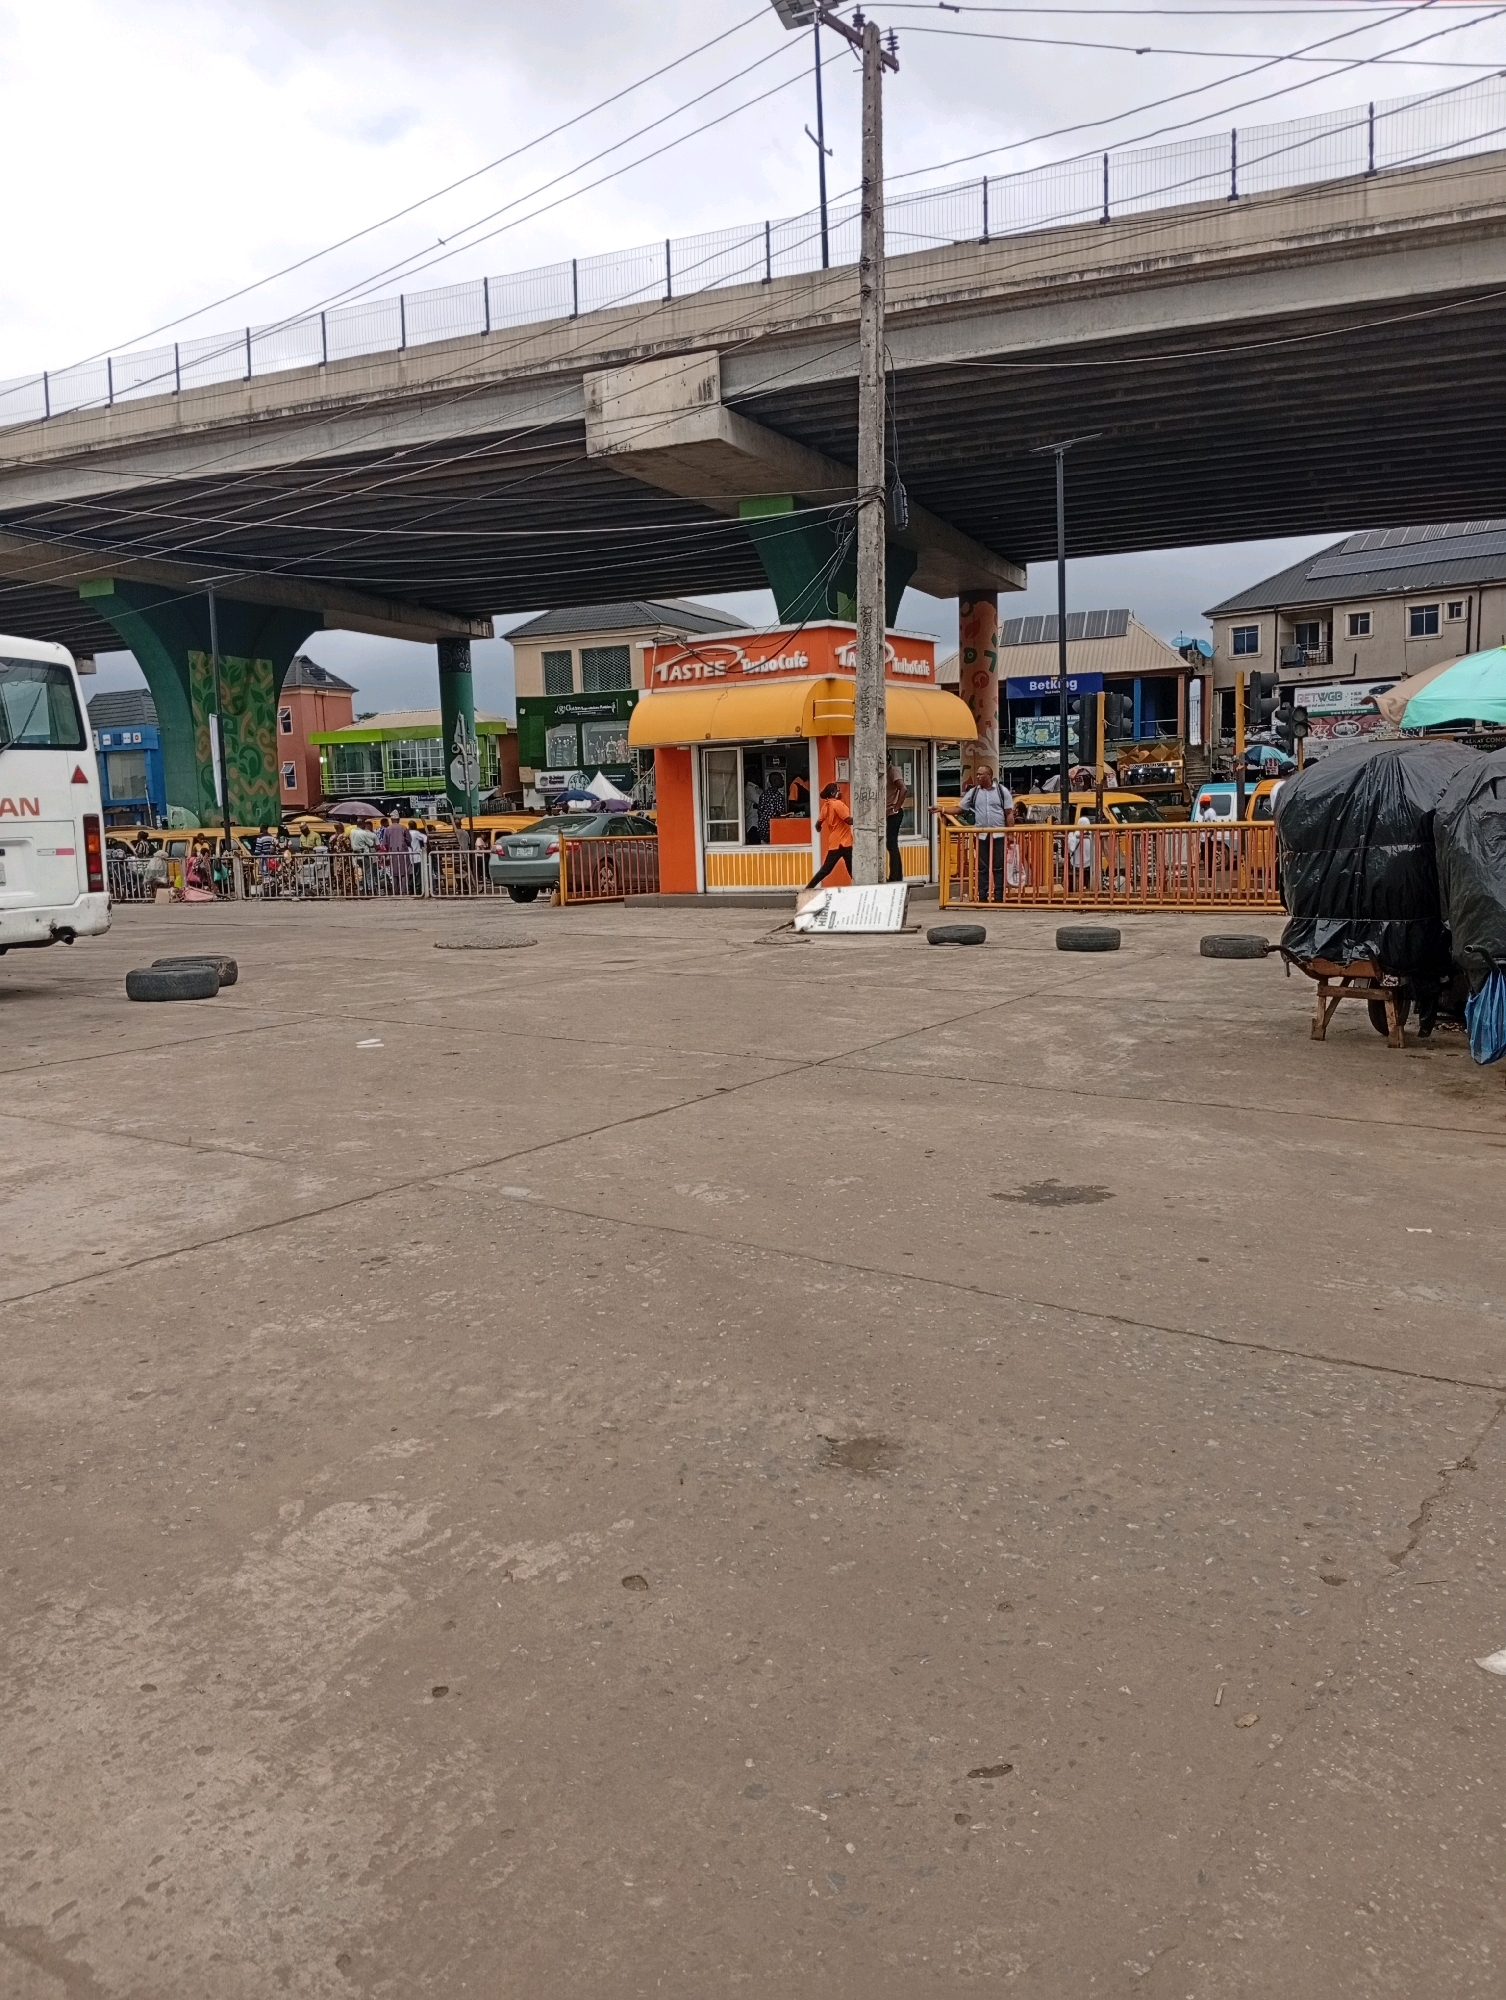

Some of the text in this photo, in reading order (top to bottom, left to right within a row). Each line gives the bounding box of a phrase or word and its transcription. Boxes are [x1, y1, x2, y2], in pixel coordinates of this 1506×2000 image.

[655, 656, 727, 682] TASTEE
[741, 650, 809, 674] TurboCafé
[892, 657, 930, 676] TurboCafé
